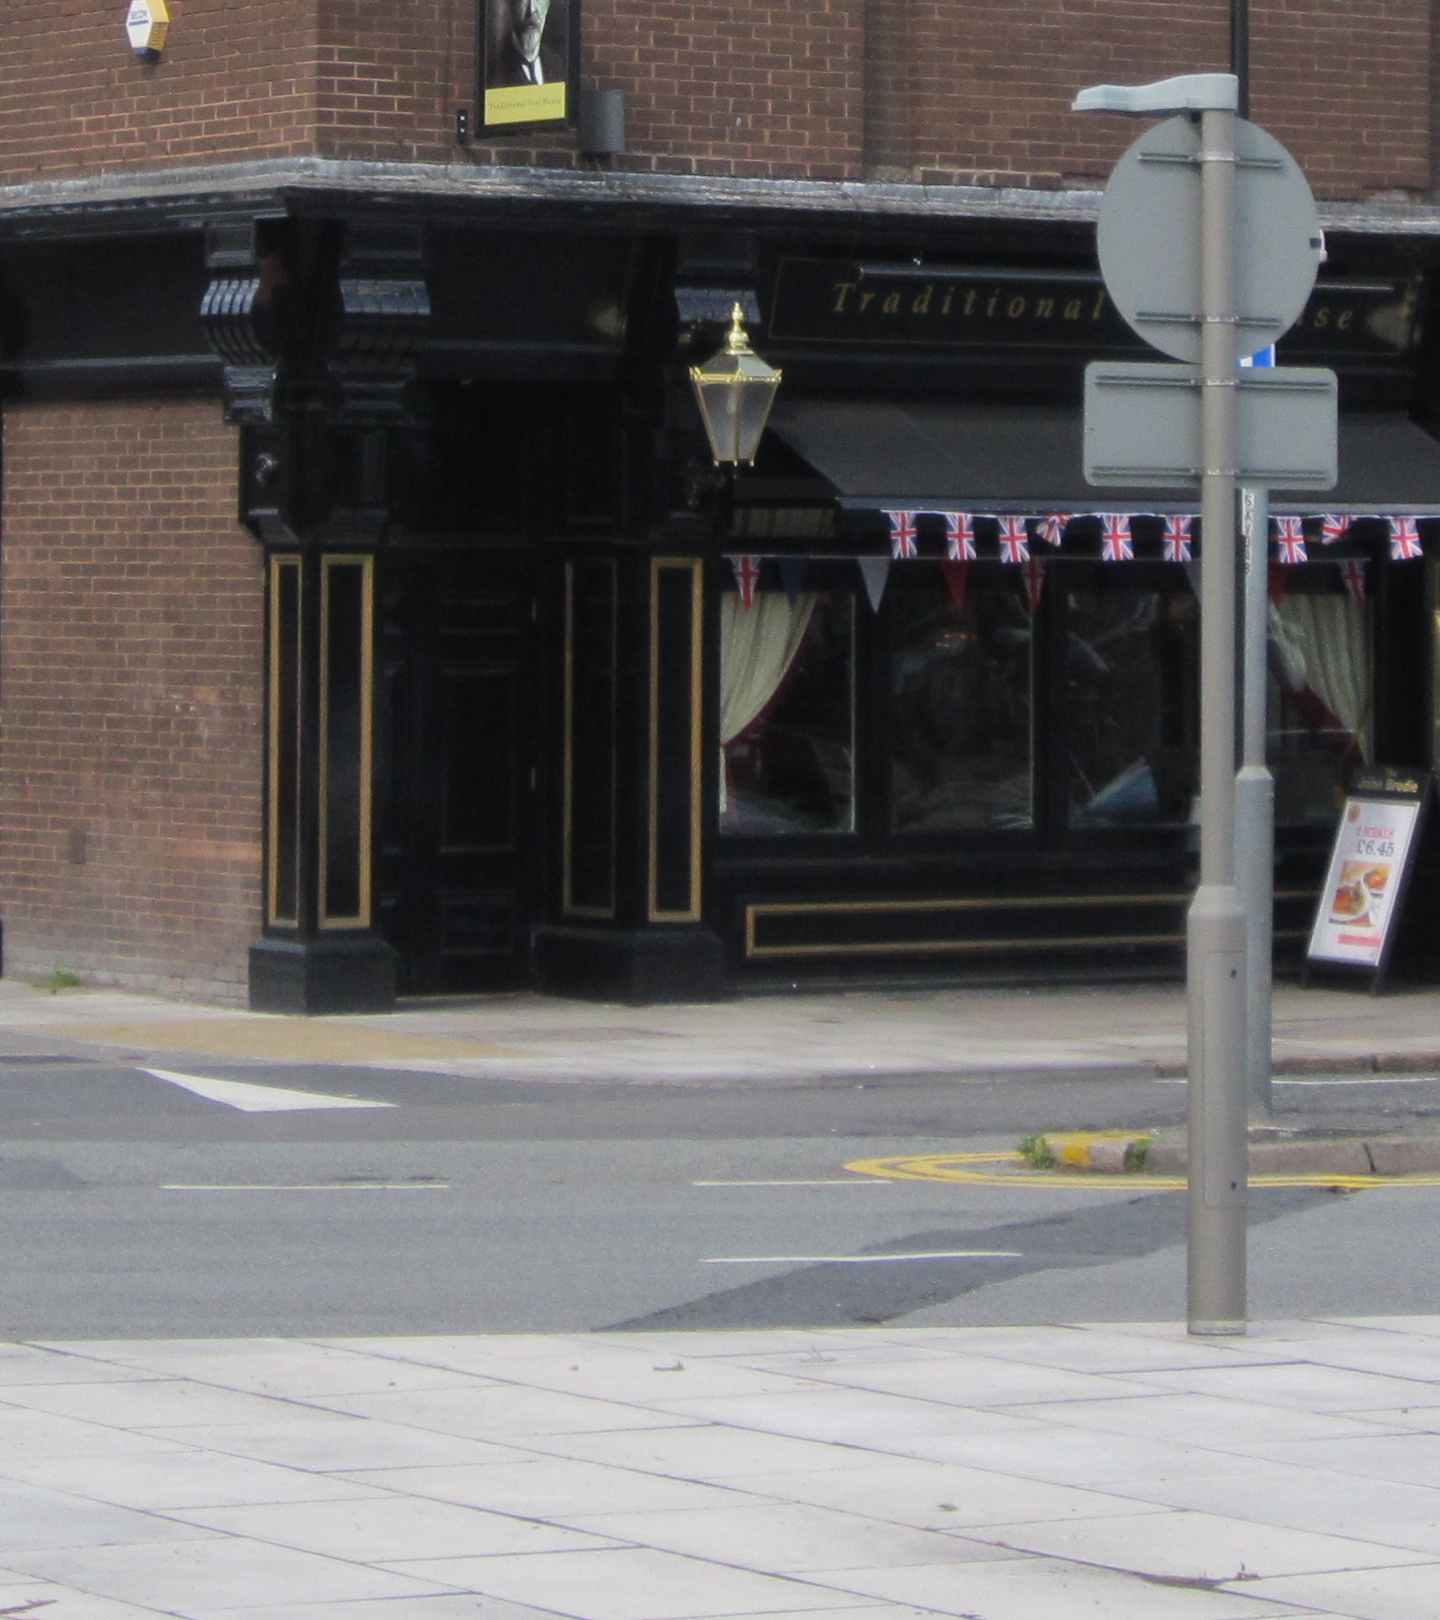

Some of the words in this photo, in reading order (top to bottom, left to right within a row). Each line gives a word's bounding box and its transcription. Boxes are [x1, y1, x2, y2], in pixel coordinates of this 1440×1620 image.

[831, 281, 1107, 321] Traditional
[1384, 778, 1419, 794] Brodie
[1355, 838, 1395, 857] £6.45
